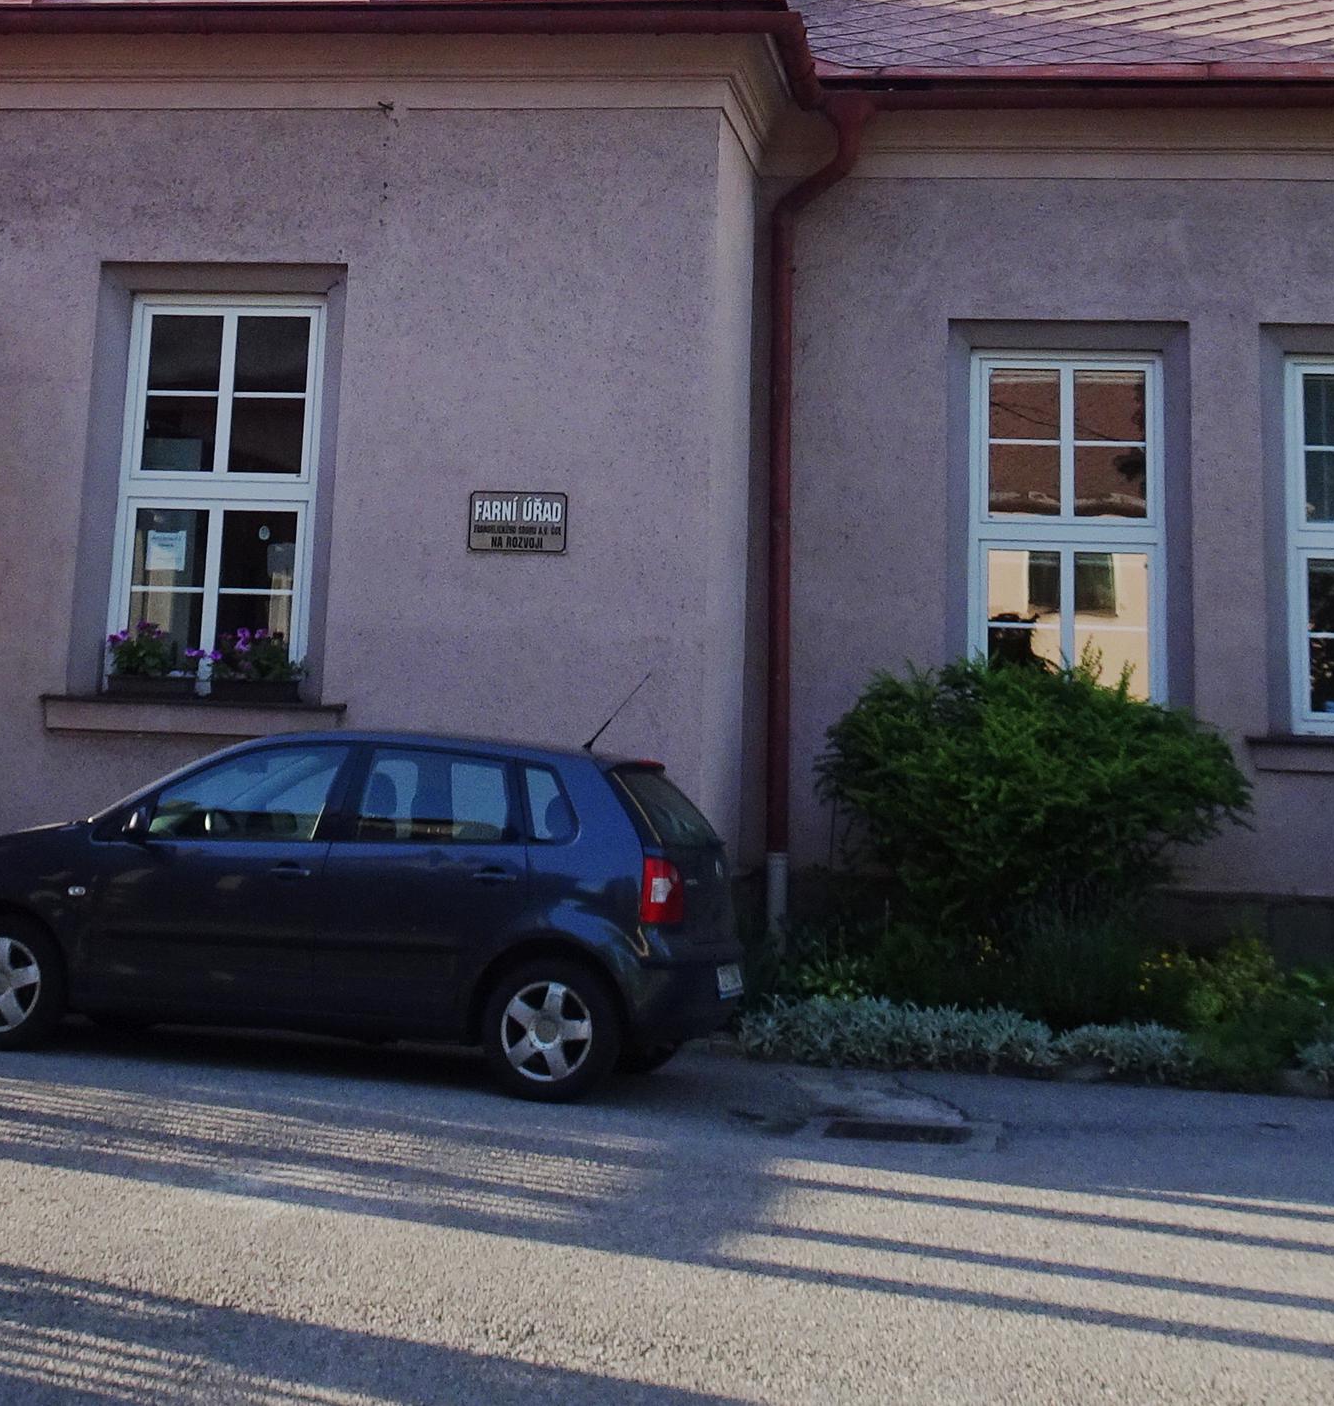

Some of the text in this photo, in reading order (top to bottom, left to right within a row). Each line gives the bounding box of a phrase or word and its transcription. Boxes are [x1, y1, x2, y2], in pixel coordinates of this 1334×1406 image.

[474, 496, 562, 522] FARNÍ ÚŘAD
[490, 536, 543, 549] NA ROZVOJI
